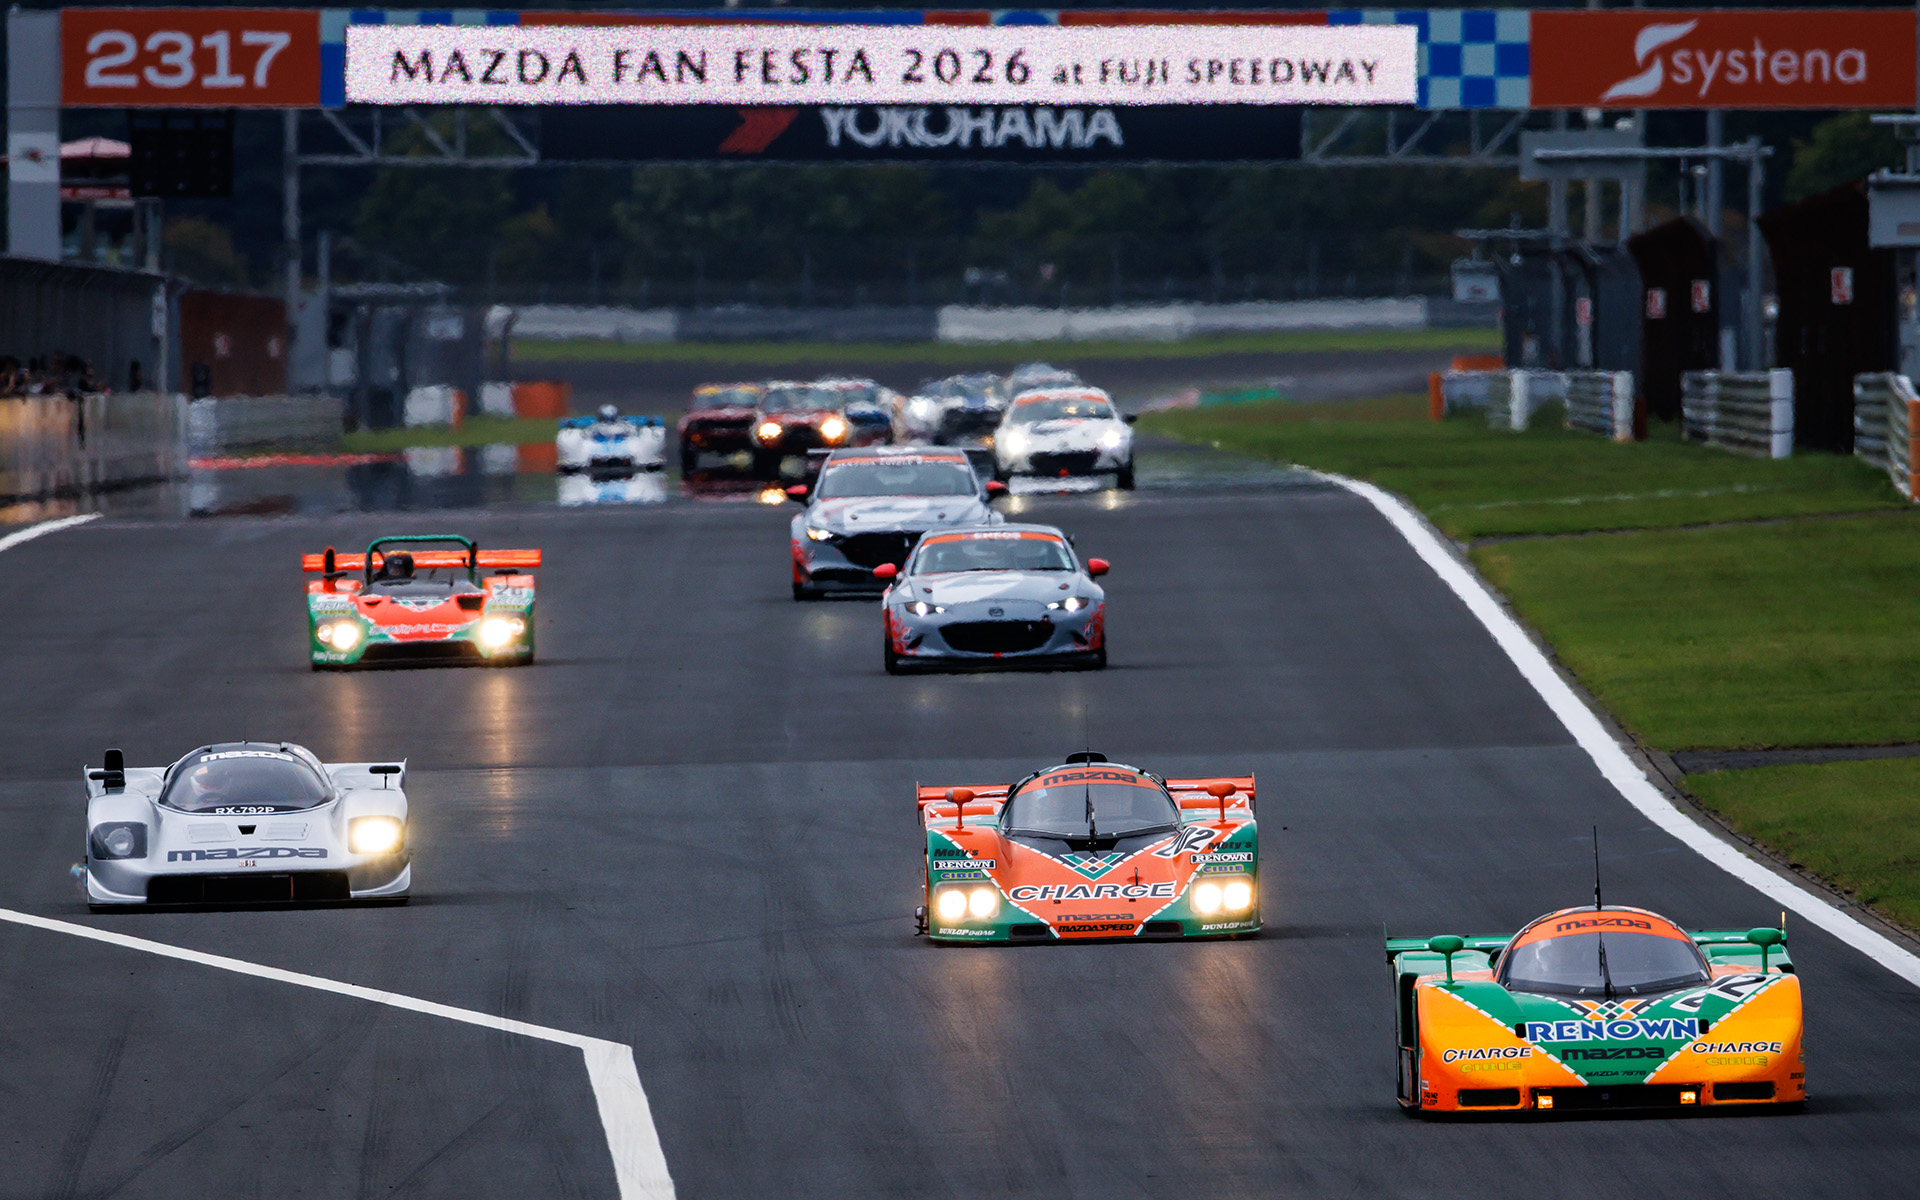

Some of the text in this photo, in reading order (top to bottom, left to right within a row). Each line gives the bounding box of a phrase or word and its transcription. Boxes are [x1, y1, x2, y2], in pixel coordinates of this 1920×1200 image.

[84, 30, 292, 87] 2317
[391, 48, 1380, 88] MAZDA FAN FESTA 2026 at FUJI SPEEDWAY
[1671, 35, 1867, 99] systena
[820, 106, 1124, 148] YOKOHAMA
[1043, 771, 1138, 786] mazda
[215, 806, 275, 815] RX-792P
[167, 847, 328, 862] mazda
[1194, 852, 1250, 863] RENOWN
[937, 860, 992, 870] RENOWN
[1010, 881, 1177, 901] CHARGE
[1057, 913, 1135, 921] mazda
[938, 927, 970, 935] DUNLOP
[1058, 924, 1135, 933] MAZDASPEED
[1201, 921, 1240, 930] DUNLOP
[1556, 918, 1652, 932] mazda
[1526, 1018, 1699, 1042] RENOWN
[1443, 1047, 1533, 1064] CHARGE
[1561, 1046, 1665, 1061] mazda
[1692, 1041, 1783, 1055] CHARGE
